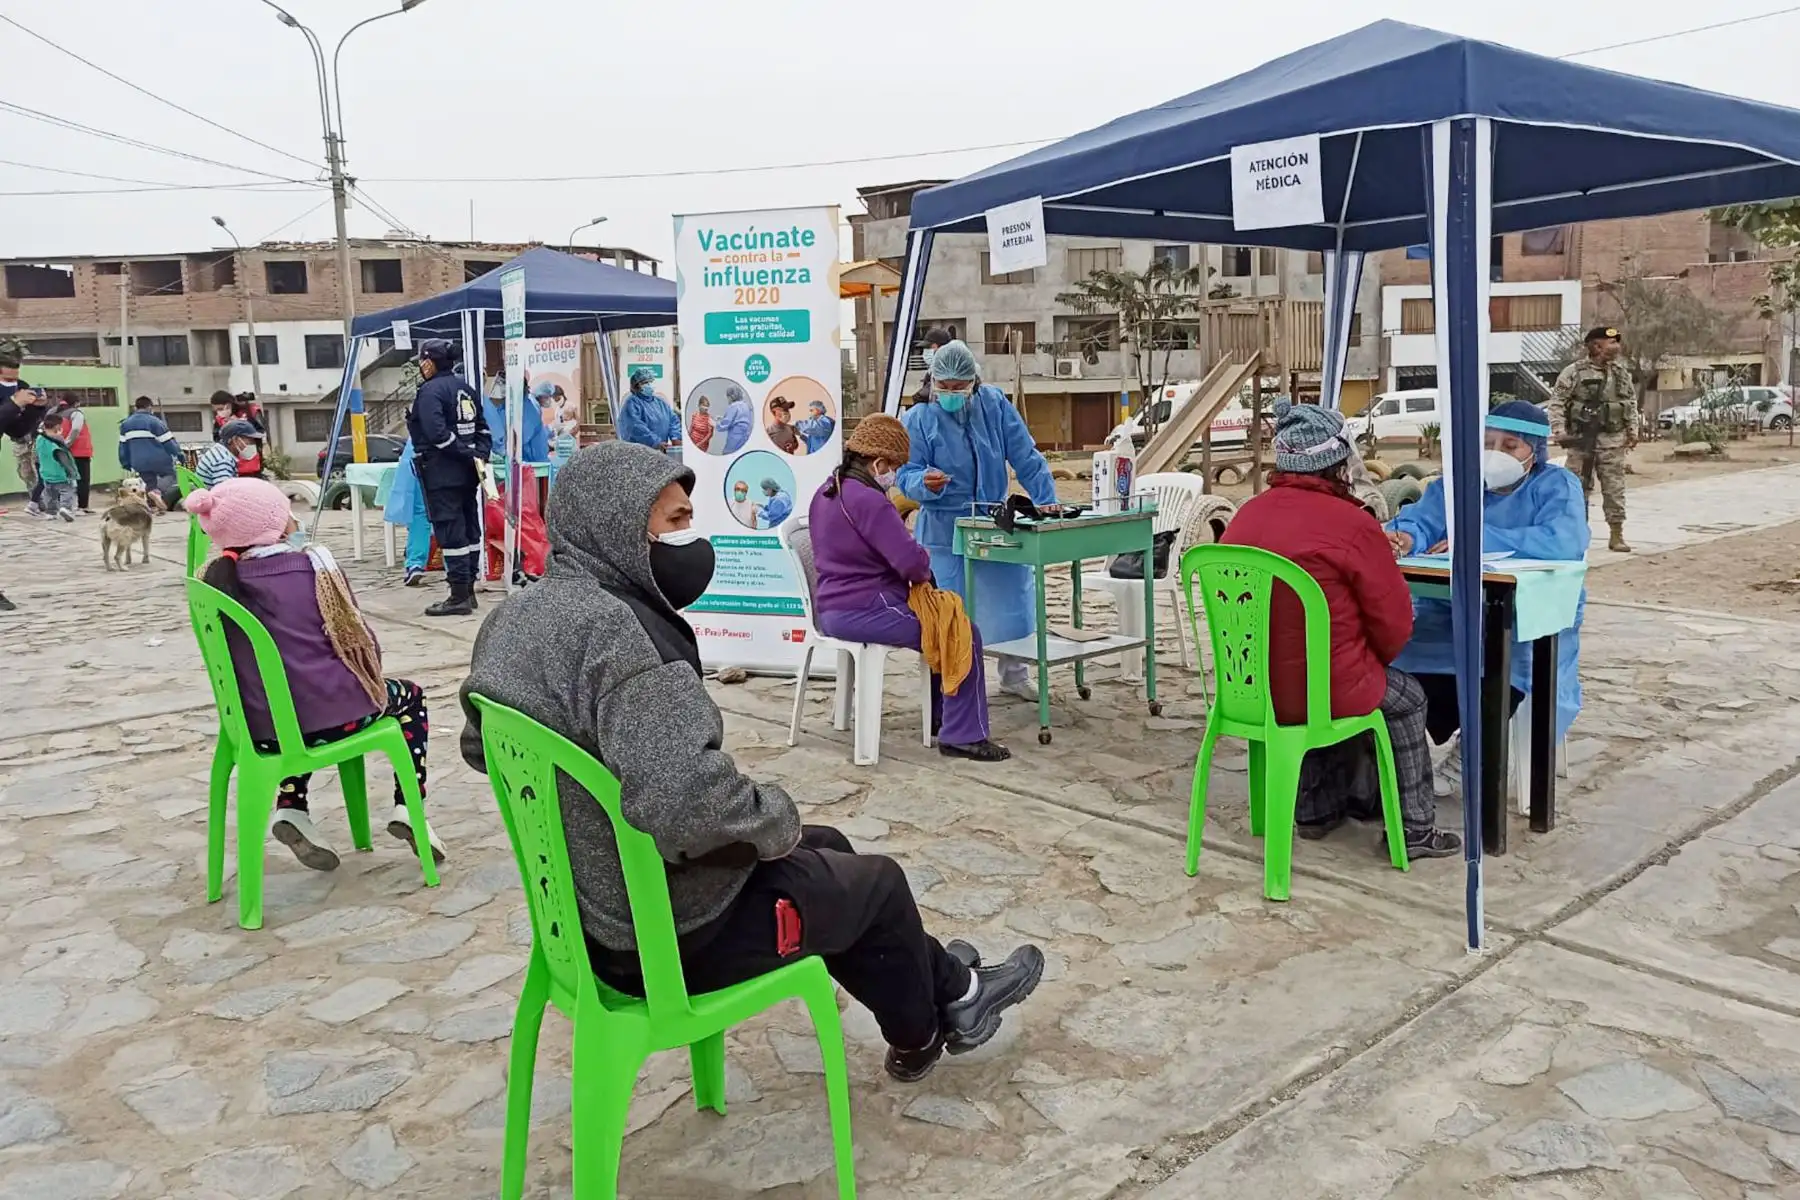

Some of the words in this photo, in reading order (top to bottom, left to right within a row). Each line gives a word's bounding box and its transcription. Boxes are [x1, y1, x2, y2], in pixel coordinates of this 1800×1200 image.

[1249, 152, 1308, 173] ATENCIÓN
[1256, 174, 1301, 190] MÉDICA
[698, 226, 816, 251] Vacúnate
[1002, 234, 1034, 248] ARTERIAL
[724, 252, 766, 264] contra
[771, 250, 783, 262] la
[704, 266, 811, 287] influenza
[734, 287, 780, 305] 2020
[528, 348, 576, 366] protege
